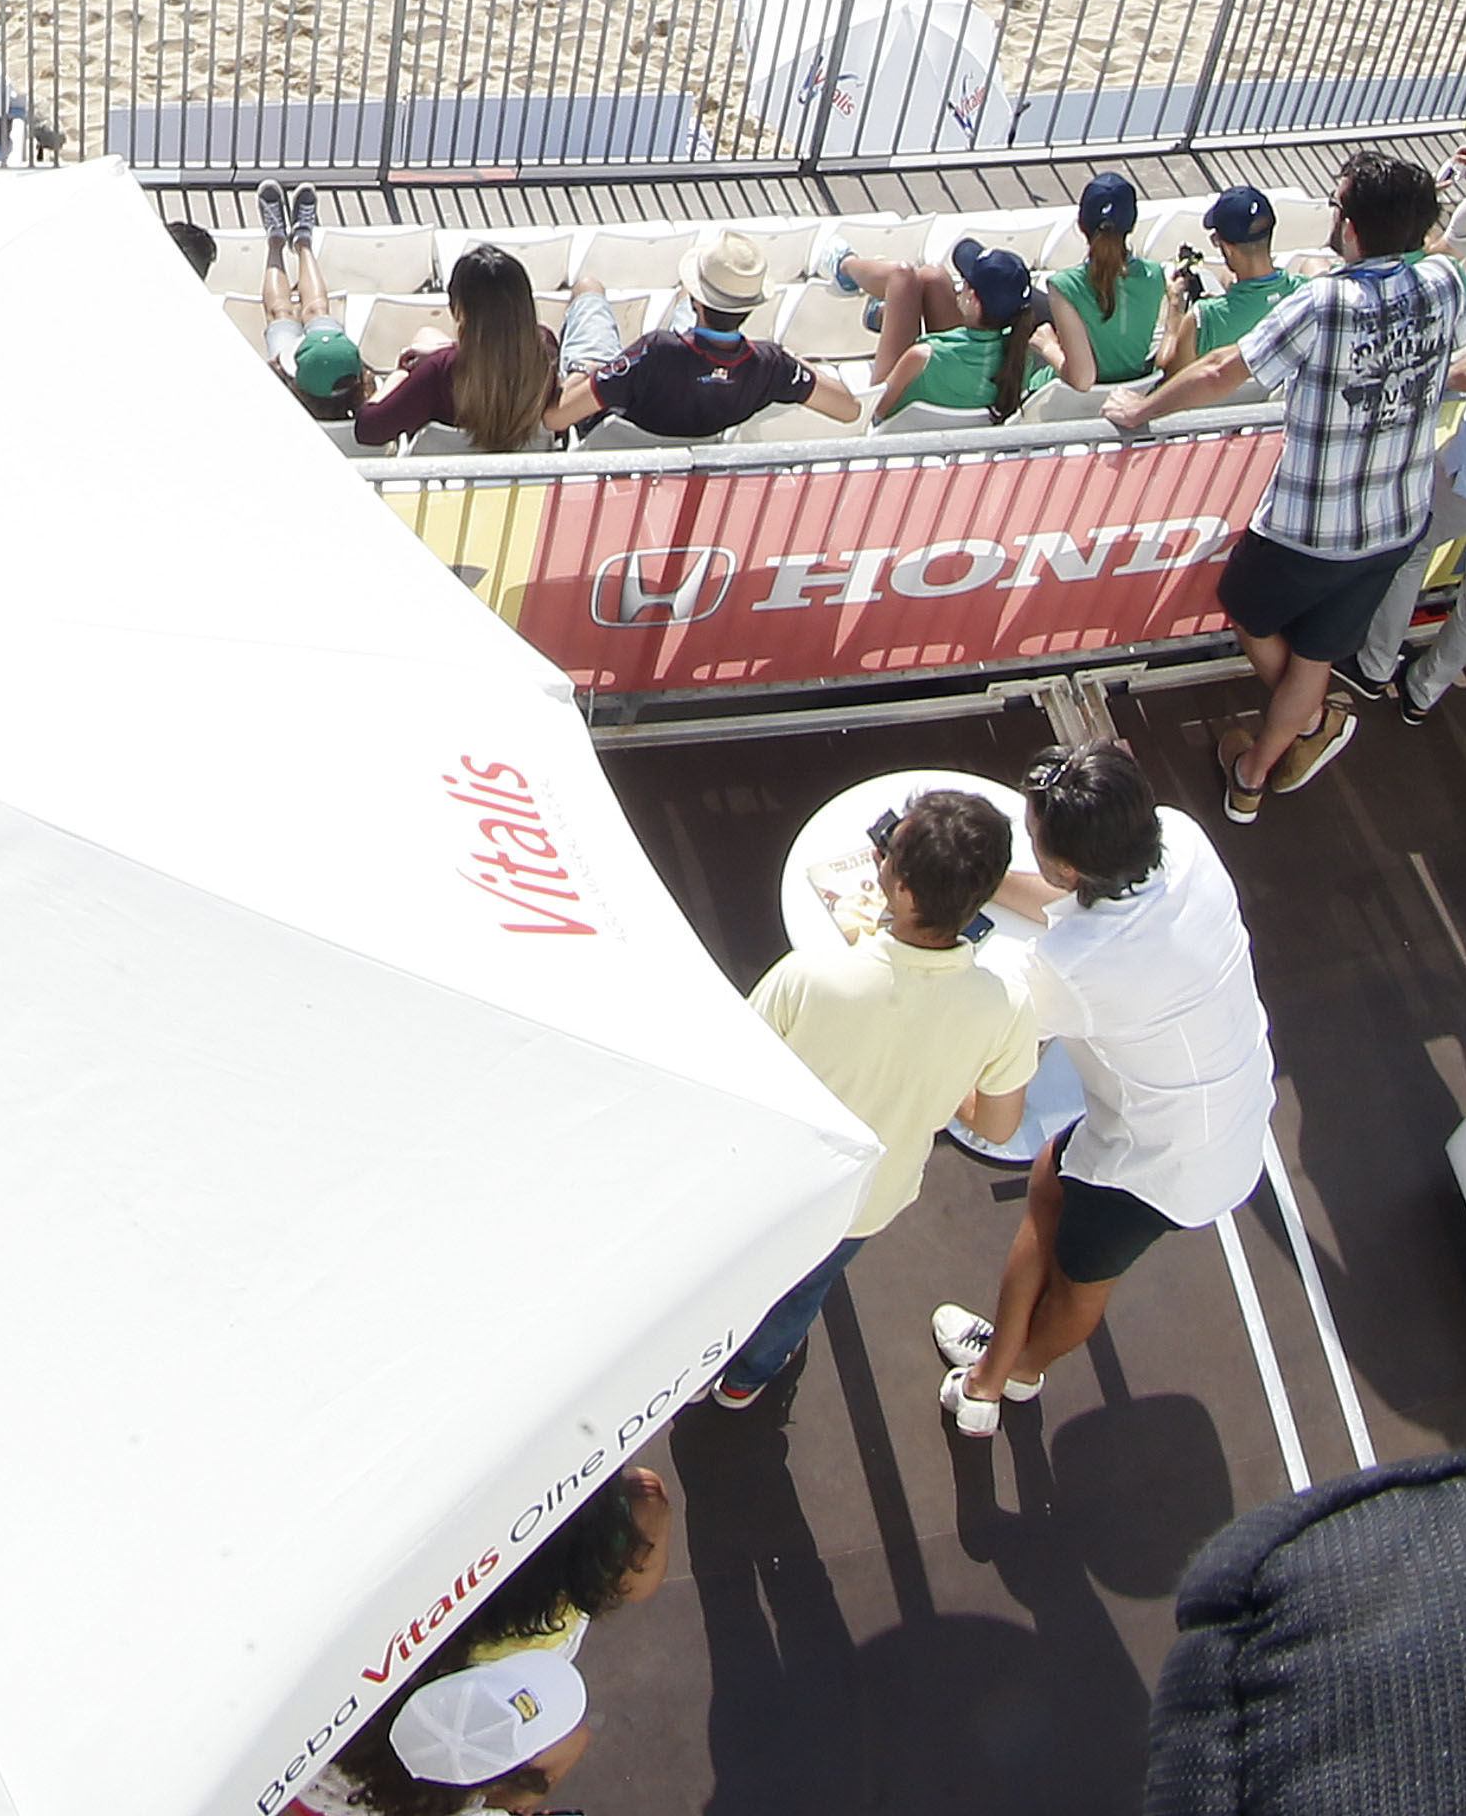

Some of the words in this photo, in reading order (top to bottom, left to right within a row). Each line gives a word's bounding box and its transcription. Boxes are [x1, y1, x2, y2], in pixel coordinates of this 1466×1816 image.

[753, 514, 1240, 615] HOND
[441, 754, 598, 936] Vitalis
[255, 1692, 360, 1816] Beba
[361, 1546, 503, 1690] Vitalis
[507, 1445, 609, 1547] Olhe
[612, 1370, 691, 1455] por
[696, 1327, 738, 1374] si
